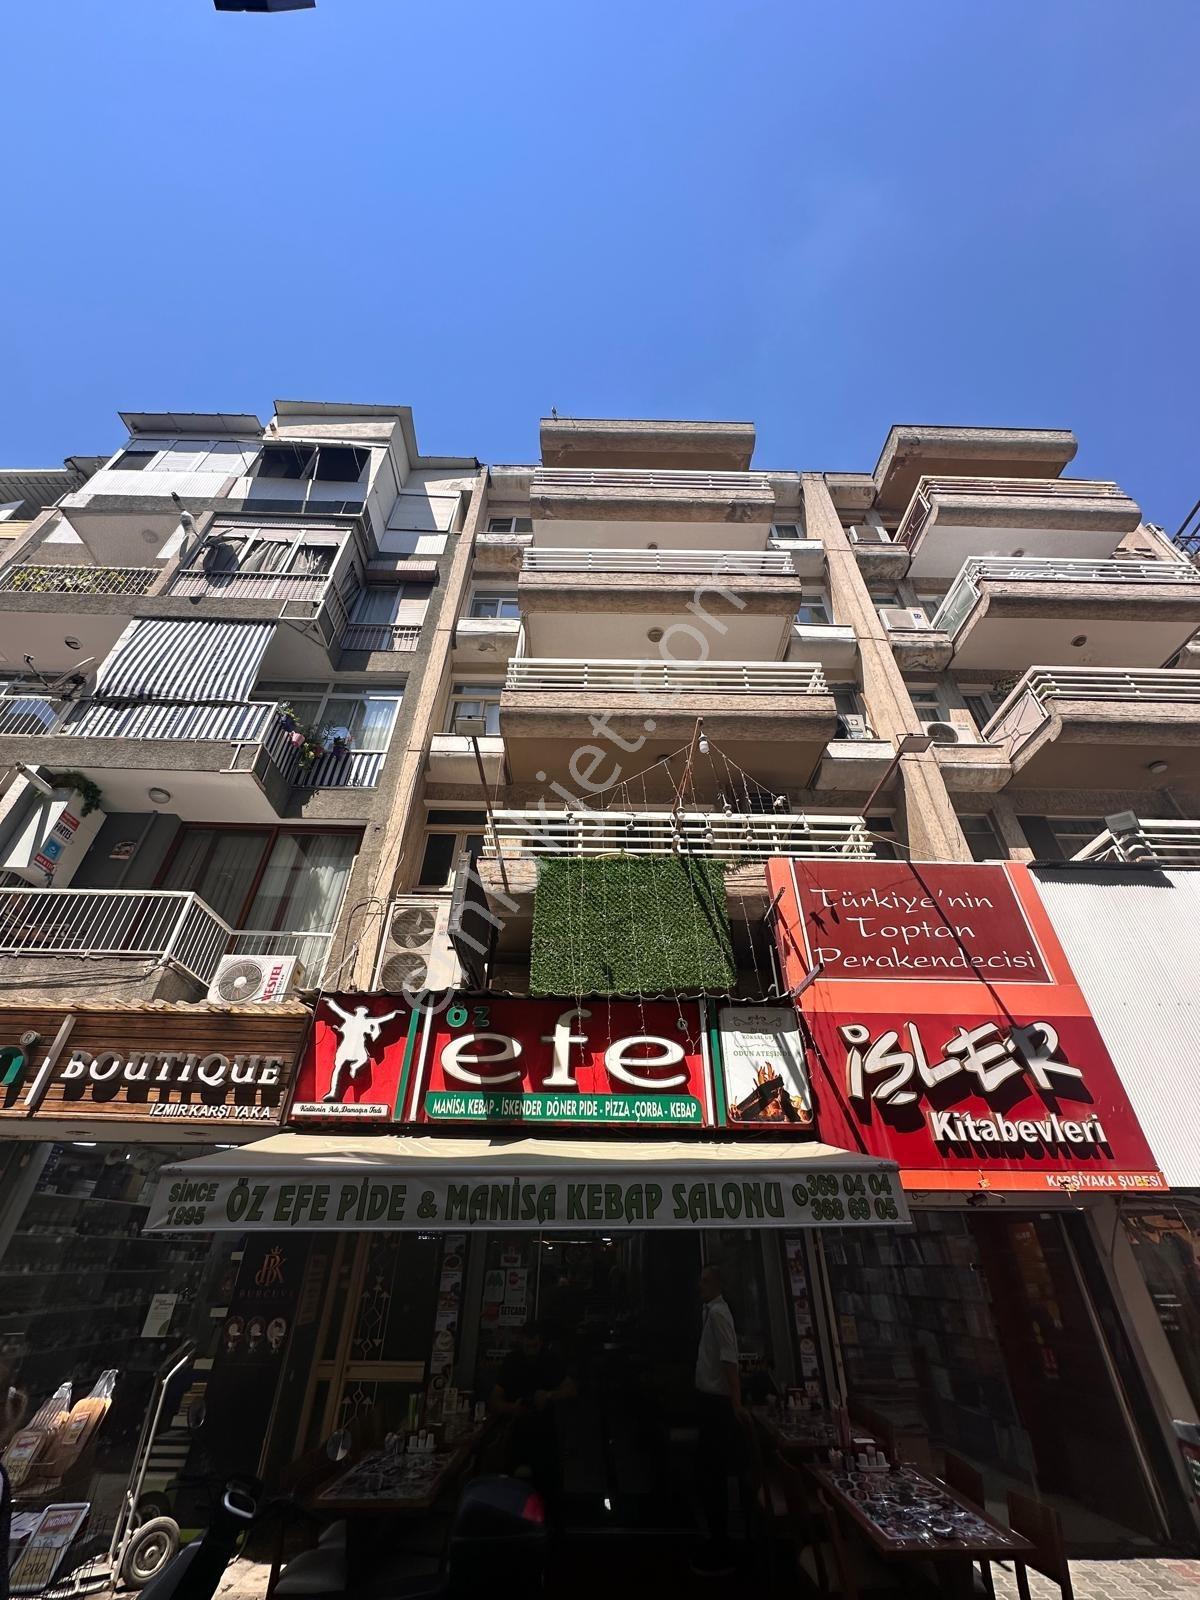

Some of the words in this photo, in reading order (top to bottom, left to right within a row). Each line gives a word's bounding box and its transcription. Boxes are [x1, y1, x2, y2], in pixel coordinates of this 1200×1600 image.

[809, 888, 994, 913] Türkiye'nin
[846, 916, 976, 945] Toptan
[814, 947, 1037, 969] Perakendecisi
[261, 964, 284, 1002] VESTEL
[446, 1001, 490, 1028] ÖZ
[440, 1008, 687, 1089] efe
[60, 1050, 285, 1087] BOUTIQUE
[431, 1095, 466, 1114] MANİSA
[467, 1099, 495, 1115] KEBAP
[501, 1097, 542, 1116] İSKENDER
[546, 1097, 578, 1117] DÖNER
[605, 1098, 630, 1117] PİZZA
[670, 1104, 697, 1118] KEBAP
[929, 1110, 1108, 1144] Kitabevleri
[169, 1178, 219, 1202] SİNCE
[806, 1174, 839, 1197] 369
[842, 1174, 866, 1196] 04
[868, 1174, 893, 1196] 04
[225, 1177, 270, 1223] ÖZ
[273, 1184, 330, 1226] EFE
[336, 1177, 407, 1222] PİDE
[417, 1190, 438, 1219] &
[444, 1176, 557, 1225] MANİSA
[566, 1183, 663, 1225] KEBAP
[671, 1182, 785, 1224] SALONU
[811, 1198, 845, 1221] 368
[848, 1198, 871, 1221] 69
[874, 1198, 899, 1221] 05
[165, 1206, 206, 1226] 1995
